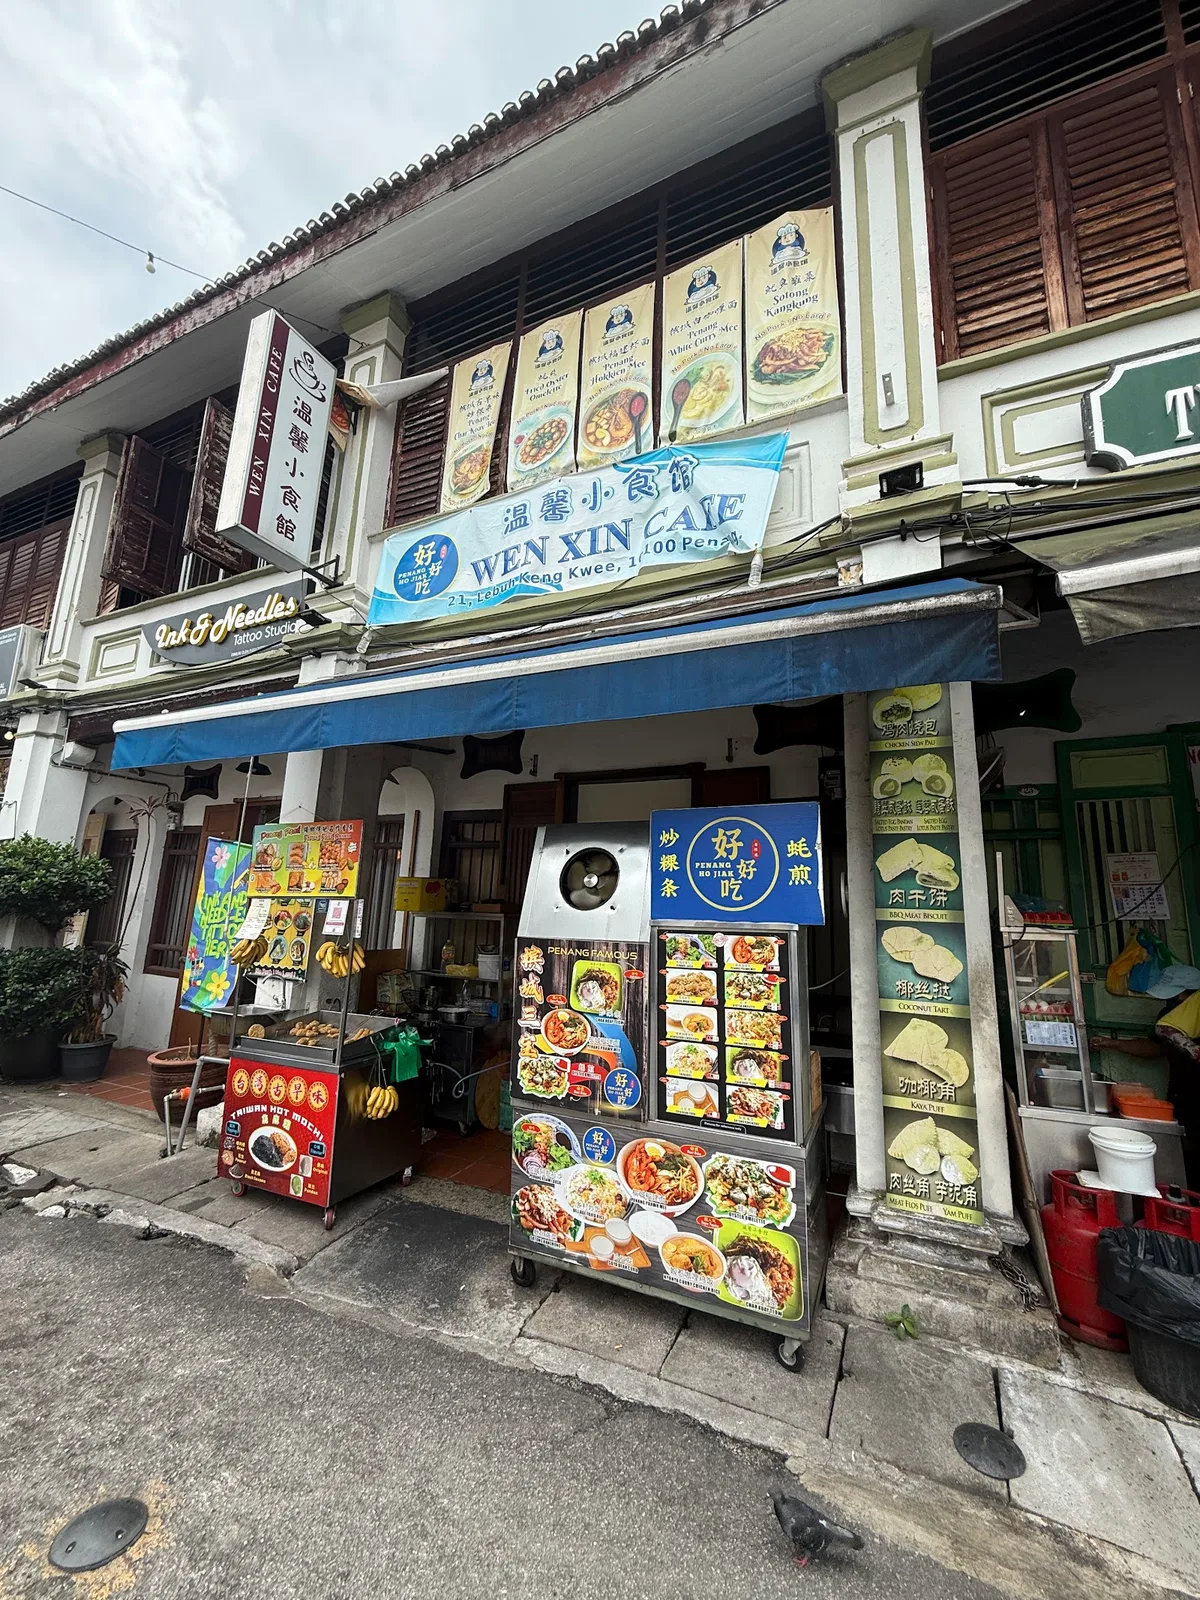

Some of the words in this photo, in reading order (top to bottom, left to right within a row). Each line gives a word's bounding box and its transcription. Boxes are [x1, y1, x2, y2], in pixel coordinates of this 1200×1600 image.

[764, 293, 818, 318] Kangkung
[773, 287, 809, 306] Sotong
[668, 341, 693, 358] White
[694, 334, 716, 349] Curry
[719, 322, 739, 335] Mee
[687, 321, 718, 340] Penang
[590, 368, 626, 386] Hokkien
[627, 359, 647, 371] Mee
[603, 355, 634, 371] Penang
[546, 373, 569, 389] Oyster
[529, 384, 562, 402] Omelette
[249, 455, 266, 497] WEN
[258, 406, 273, 443] XIN
[266, 346, 283, 393] CAFE
[1165, 384, 1200, 441] T
[503, 454, 700, 536] 温馨小食馆
[470, 536, 550, 587] WEN
[558, 517, 633, 564] XIN
[644, 492, 748, 539] CAFE
[397, 568, 426, 580] PENANG
[398, 577, 410, 586] HO
[410, 573, 428, 583] JIAK
[448, 593, 474, 609] 21,
[477, 577, 517, 604] Lebuh
[518, 570, 563, 588] Keng
[568, 561, 623, 577] Kwee,
[155, 618, 191, 649] Ink
[209, 592, 300, 644] Needles
[234, 629, 263, 647] Tattoo
[265, 620, 298, 639] Studio
[881, 717, 939, 738] 鸡肉烧包
[884, 740, 910, 748] CHICKEN
[1189, 749, 1200, 764] N
[659, 828, 680, 898] 炒粿条
[695, 861, 732, 869] PENANG
[711, 828, 757, 901] 好好吃
[787, 837, 812, 886] 蚝煎
[713, 870, 735, 878] JIAK
[204, 890, 221, 909] INK
[221, 890, 247, 910] AND
[889, 888, 949, 908] 肉干饼
[889, 911, 903, 920] BBQ
[903, 911, 922, 920] MEAT
[922, 912, 948, 921] BISCUIT
[547, 946, 590, 957] PENANG
[591, 949, 638, 960] FAMOUS
[896, 979, 953, 1000] 椰丝挞
[517, 944, 545, 1060] 槟城三宝
[898, 1002, 932, 1013] COCONUT
[932, 1005, 950, 1014] TART
[898, 1077, 957, 1102] 咖椰角
[911, 1101, 928, 1111] KAYA
[928, 1104, 945, 1113] PUFF
[230, 1104, 267, 1120] TAIWAN
[270, 1105, 290, 1117] HOT
[292, 1112, 324, 1141] MOCHI
[889, 1173, 931, 1200] 肉丝角
[935, 1179, 978, 1208] 芋泥角
[889, 1196, 904, 1208] MEAT
[905, 1198, 919, 1210] FLOS
[920, 1202, 933, 1212] PUFF
[943, 1207, 957, 1218] YAM
[958, 1210, 973, 1221] PUFF
